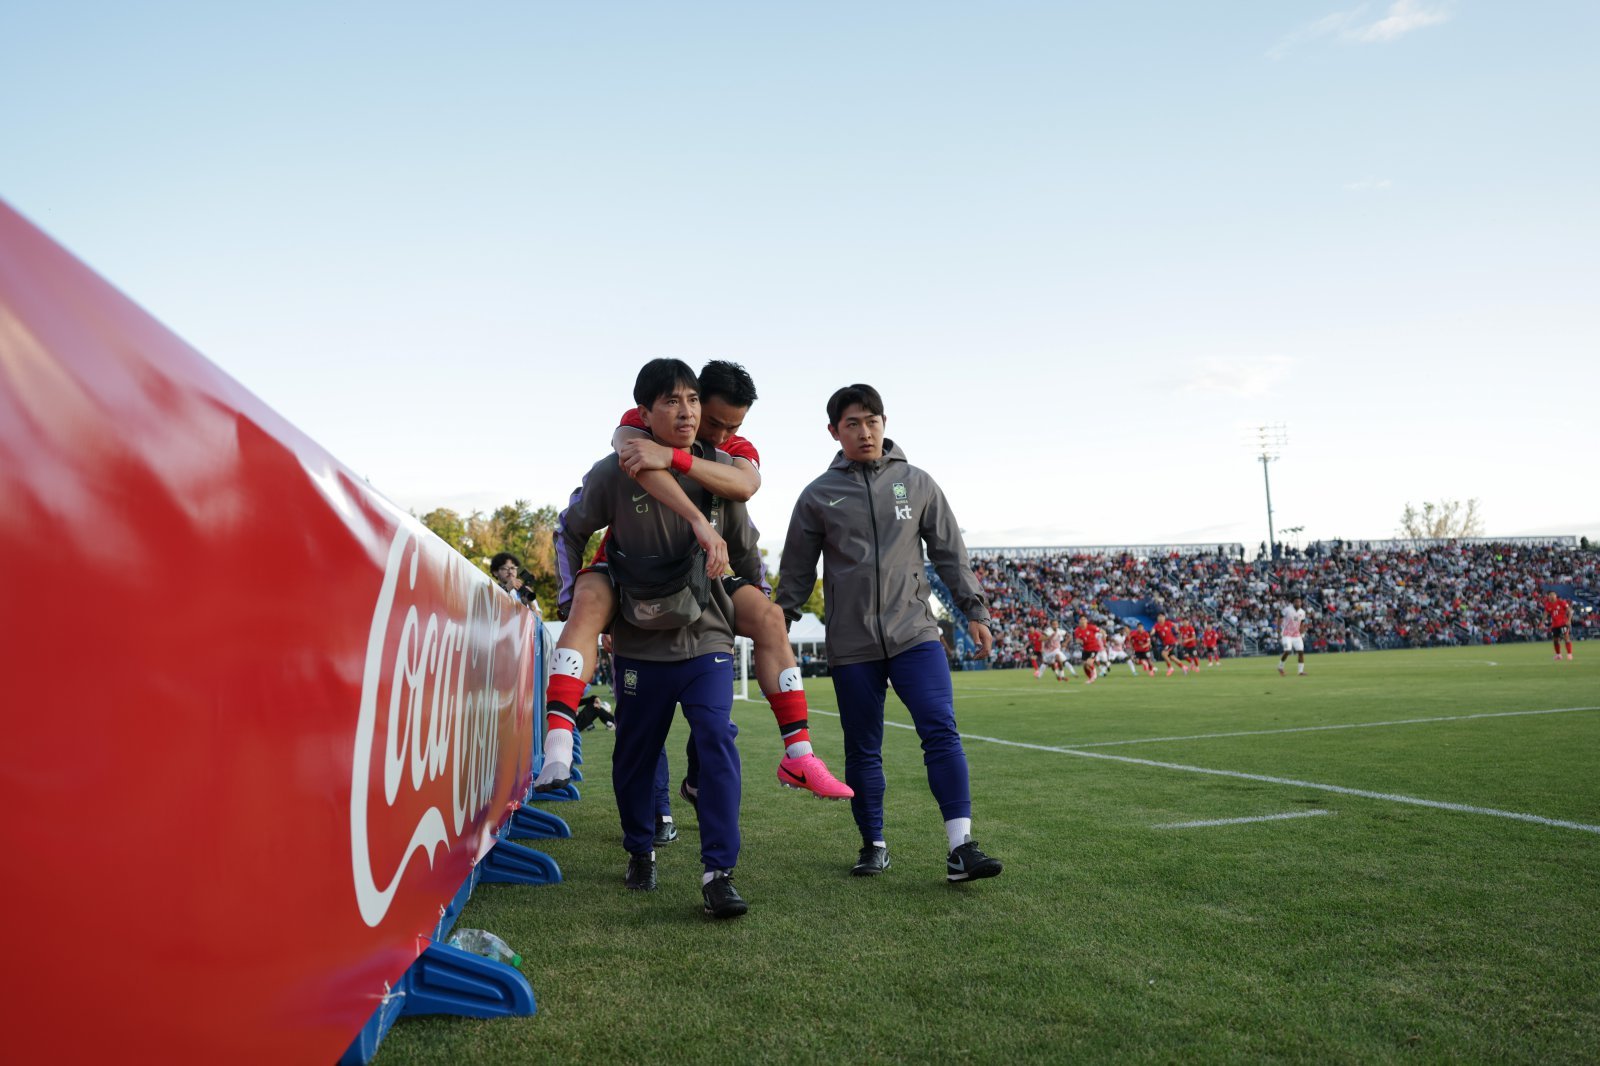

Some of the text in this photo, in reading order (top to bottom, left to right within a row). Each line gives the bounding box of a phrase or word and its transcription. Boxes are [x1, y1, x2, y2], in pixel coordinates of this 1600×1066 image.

[635, 503, 649, 514] CJ
[894, 504, 912, 520] kt
[1020, 548, 1070, 560] YOUNG
